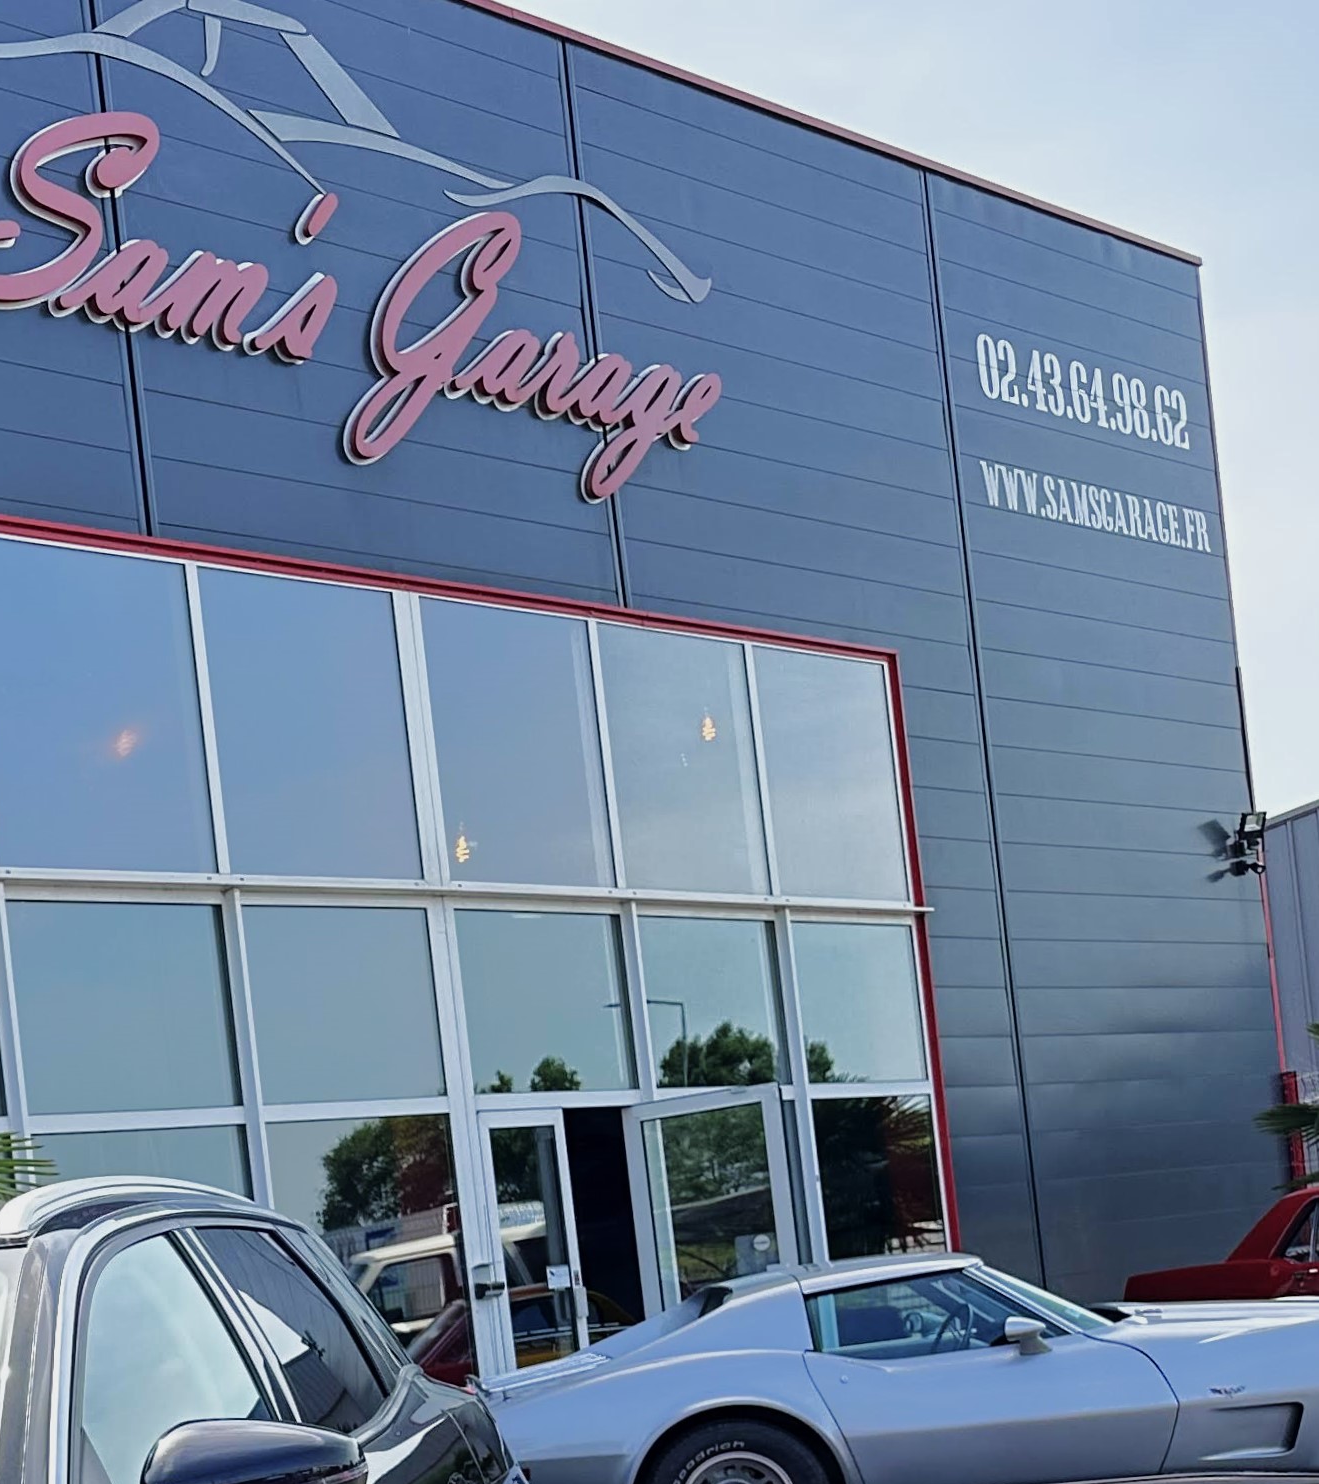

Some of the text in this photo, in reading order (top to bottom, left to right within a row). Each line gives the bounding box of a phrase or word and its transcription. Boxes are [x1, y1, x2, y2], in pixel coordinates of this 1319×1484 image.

[343, 211, 723, 504] Garage
[976, 333, 1190, 450] 02.43.64.98.62
[979, 460, 1212, 553] WWW.SAMSGARAGE.FR
